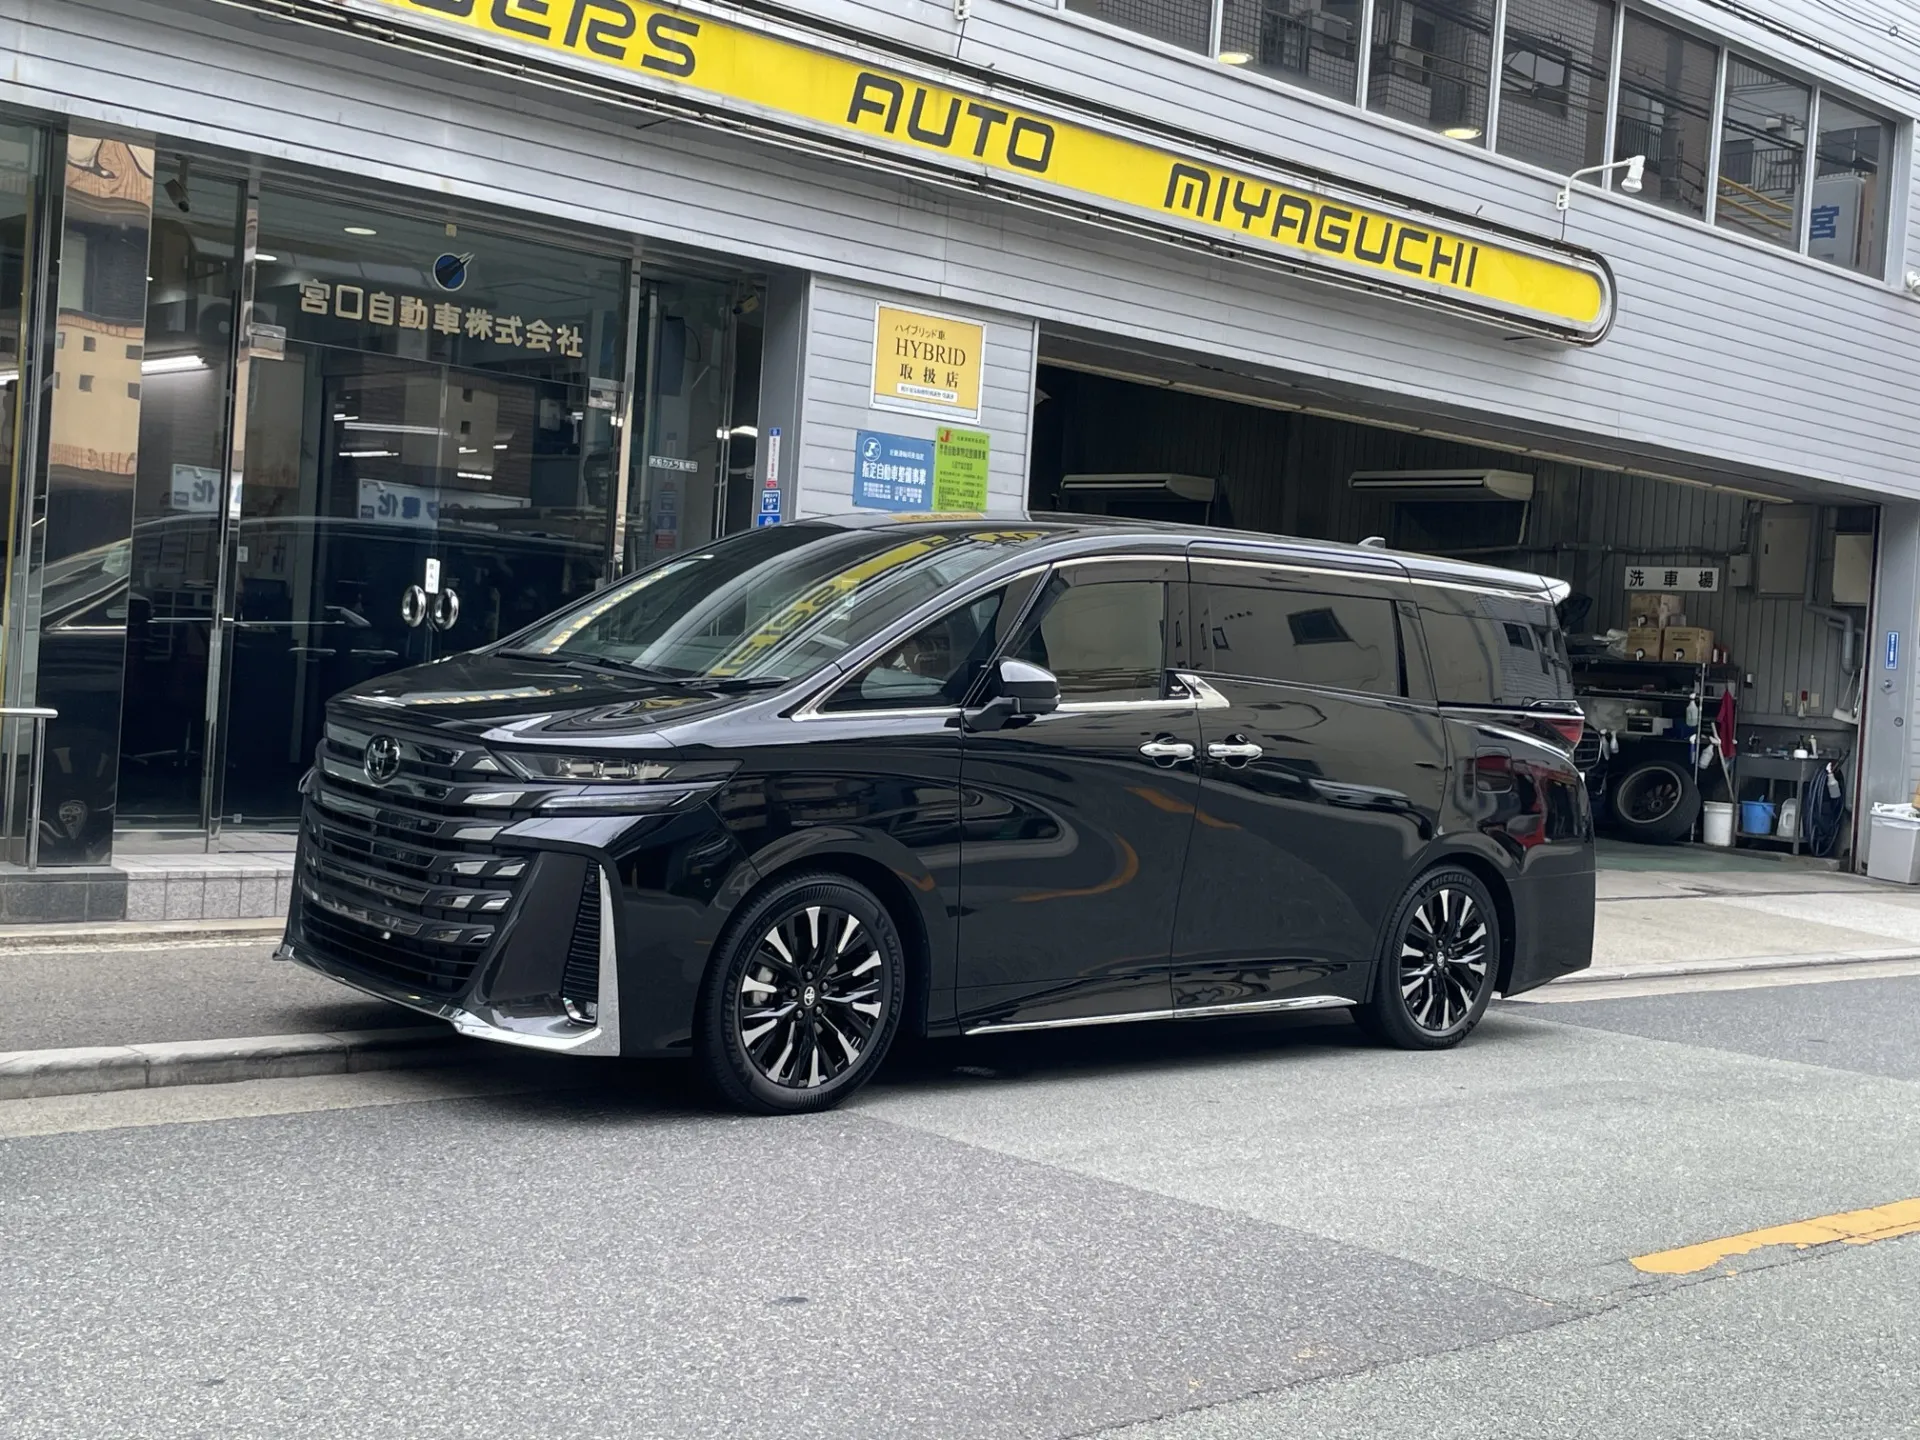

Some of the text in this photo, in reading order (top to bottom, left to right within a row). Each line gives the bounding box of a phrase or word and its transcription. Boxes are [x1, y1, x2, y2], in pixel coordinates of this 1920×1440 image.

[847, 71, 1055, 173] AUTO
[1163, 163, 1478, 288] MIYAGUCHI
[299, 278, 584, 359] 宮口自動車株式会社
[894, 323, 946, 341] ハイブリッド車
[896, 336, 967, 367] HYBRID
[899, 363, 960, 389] 取扱店
[861, 460, 927, 486] 指定自動車整備事業
[1629, 569, 1715, 589] 洗車場
